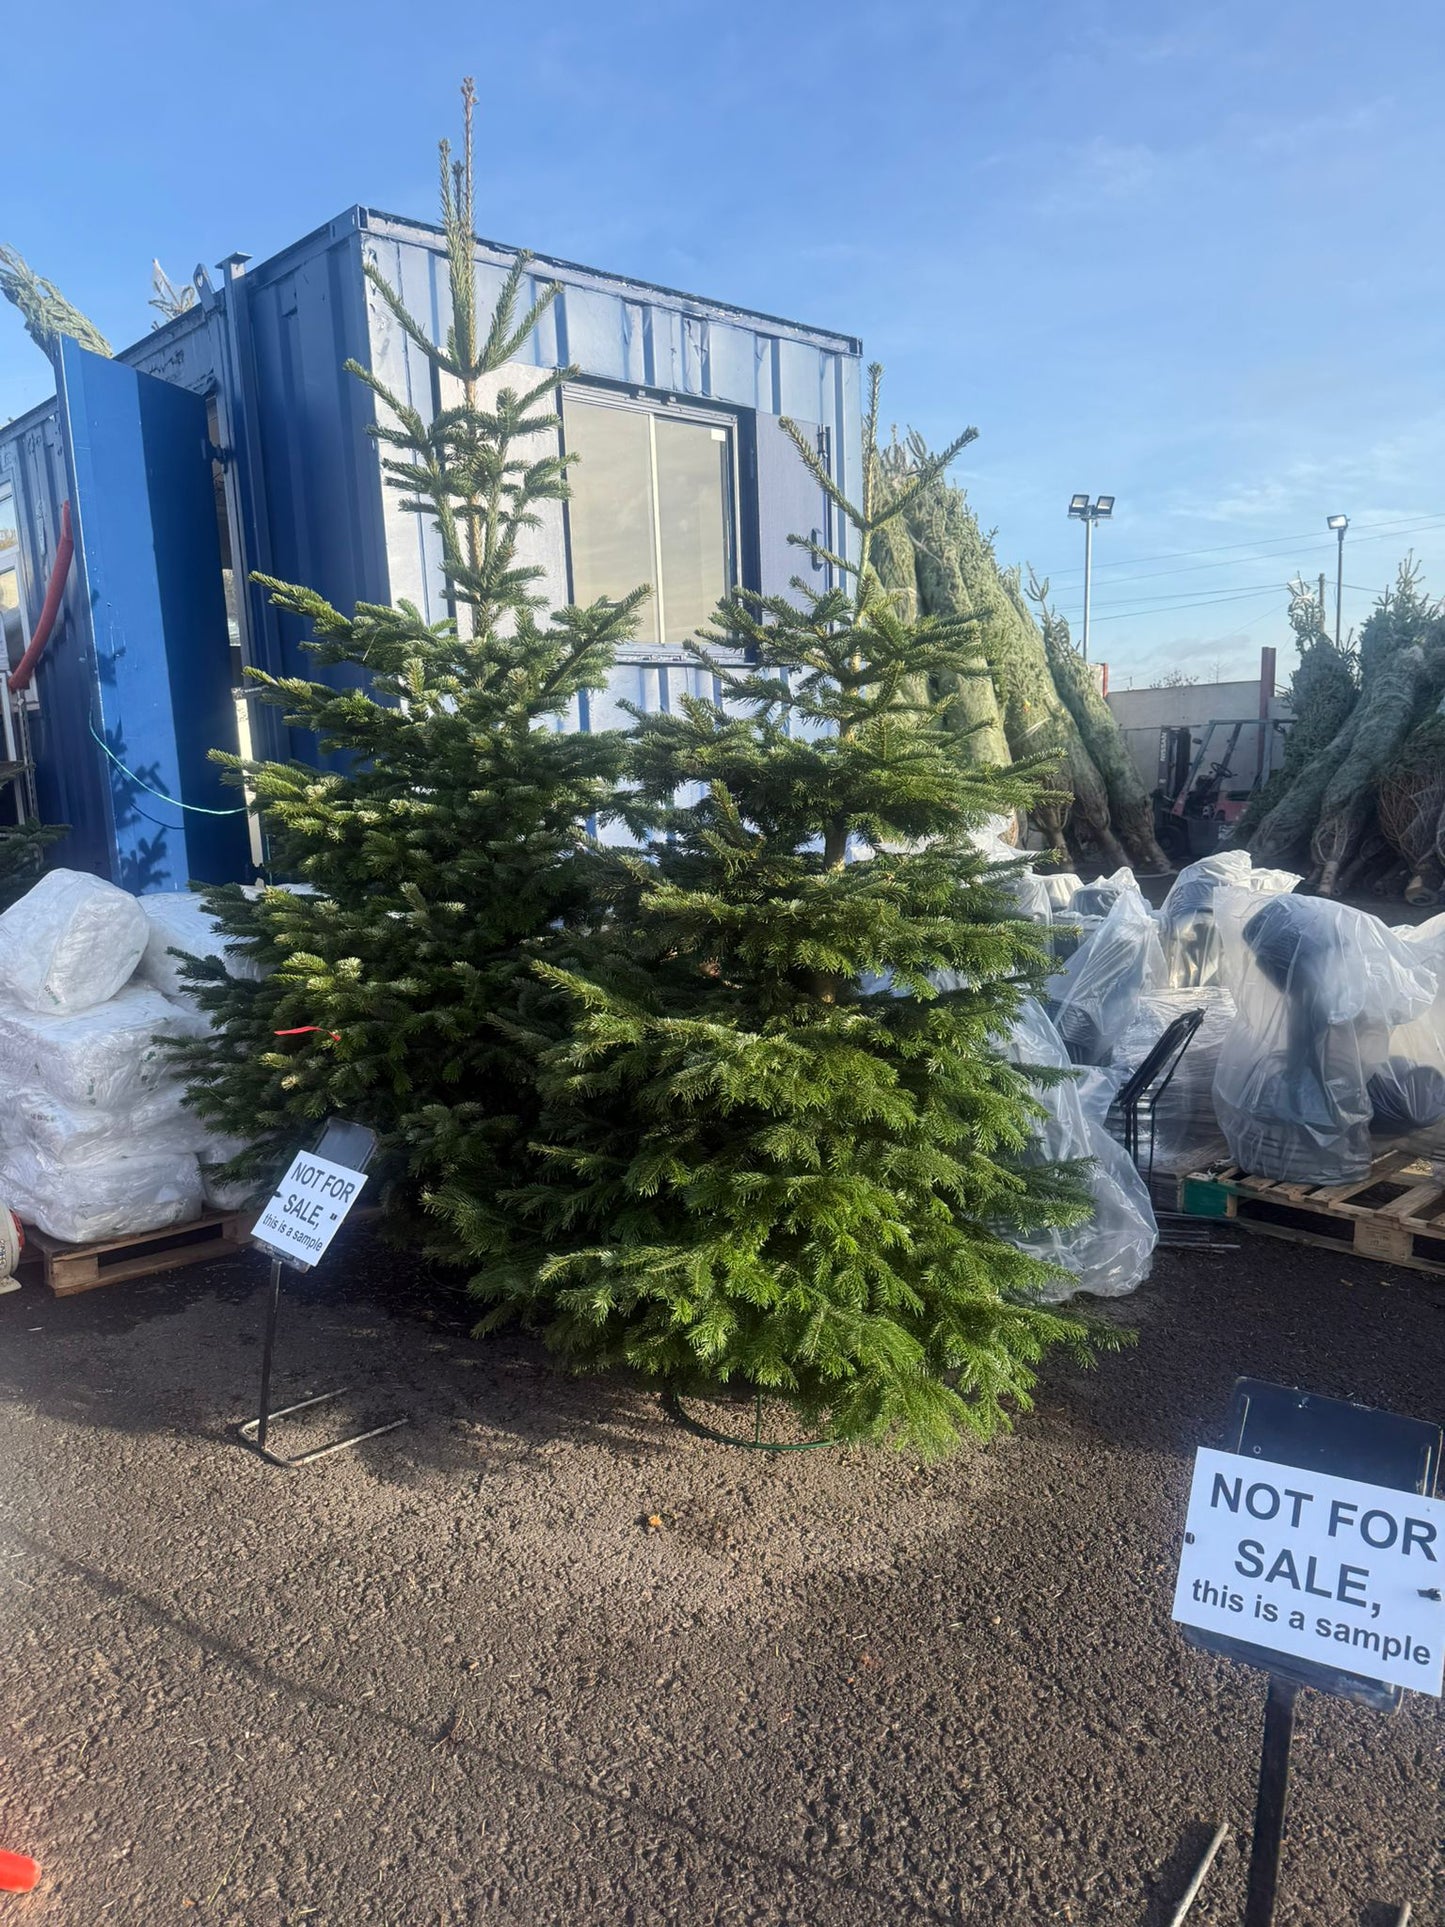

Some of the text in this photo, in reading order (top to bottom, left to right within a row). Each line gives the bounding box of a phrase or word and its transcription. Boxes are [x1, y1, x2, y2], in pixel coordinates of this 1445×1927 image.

[283, 1194, 324, 1230] SALE,
[290, 1162, 355, 1203] NOT FOR
[262, 1213, 323, 1251] this is a sample
[1210, 1472, 1438, 1562] NOT FOR
[1234, 1539, 1381, 1618] SALE,
[1192, 1578, 1431, 1665] this is a sample
